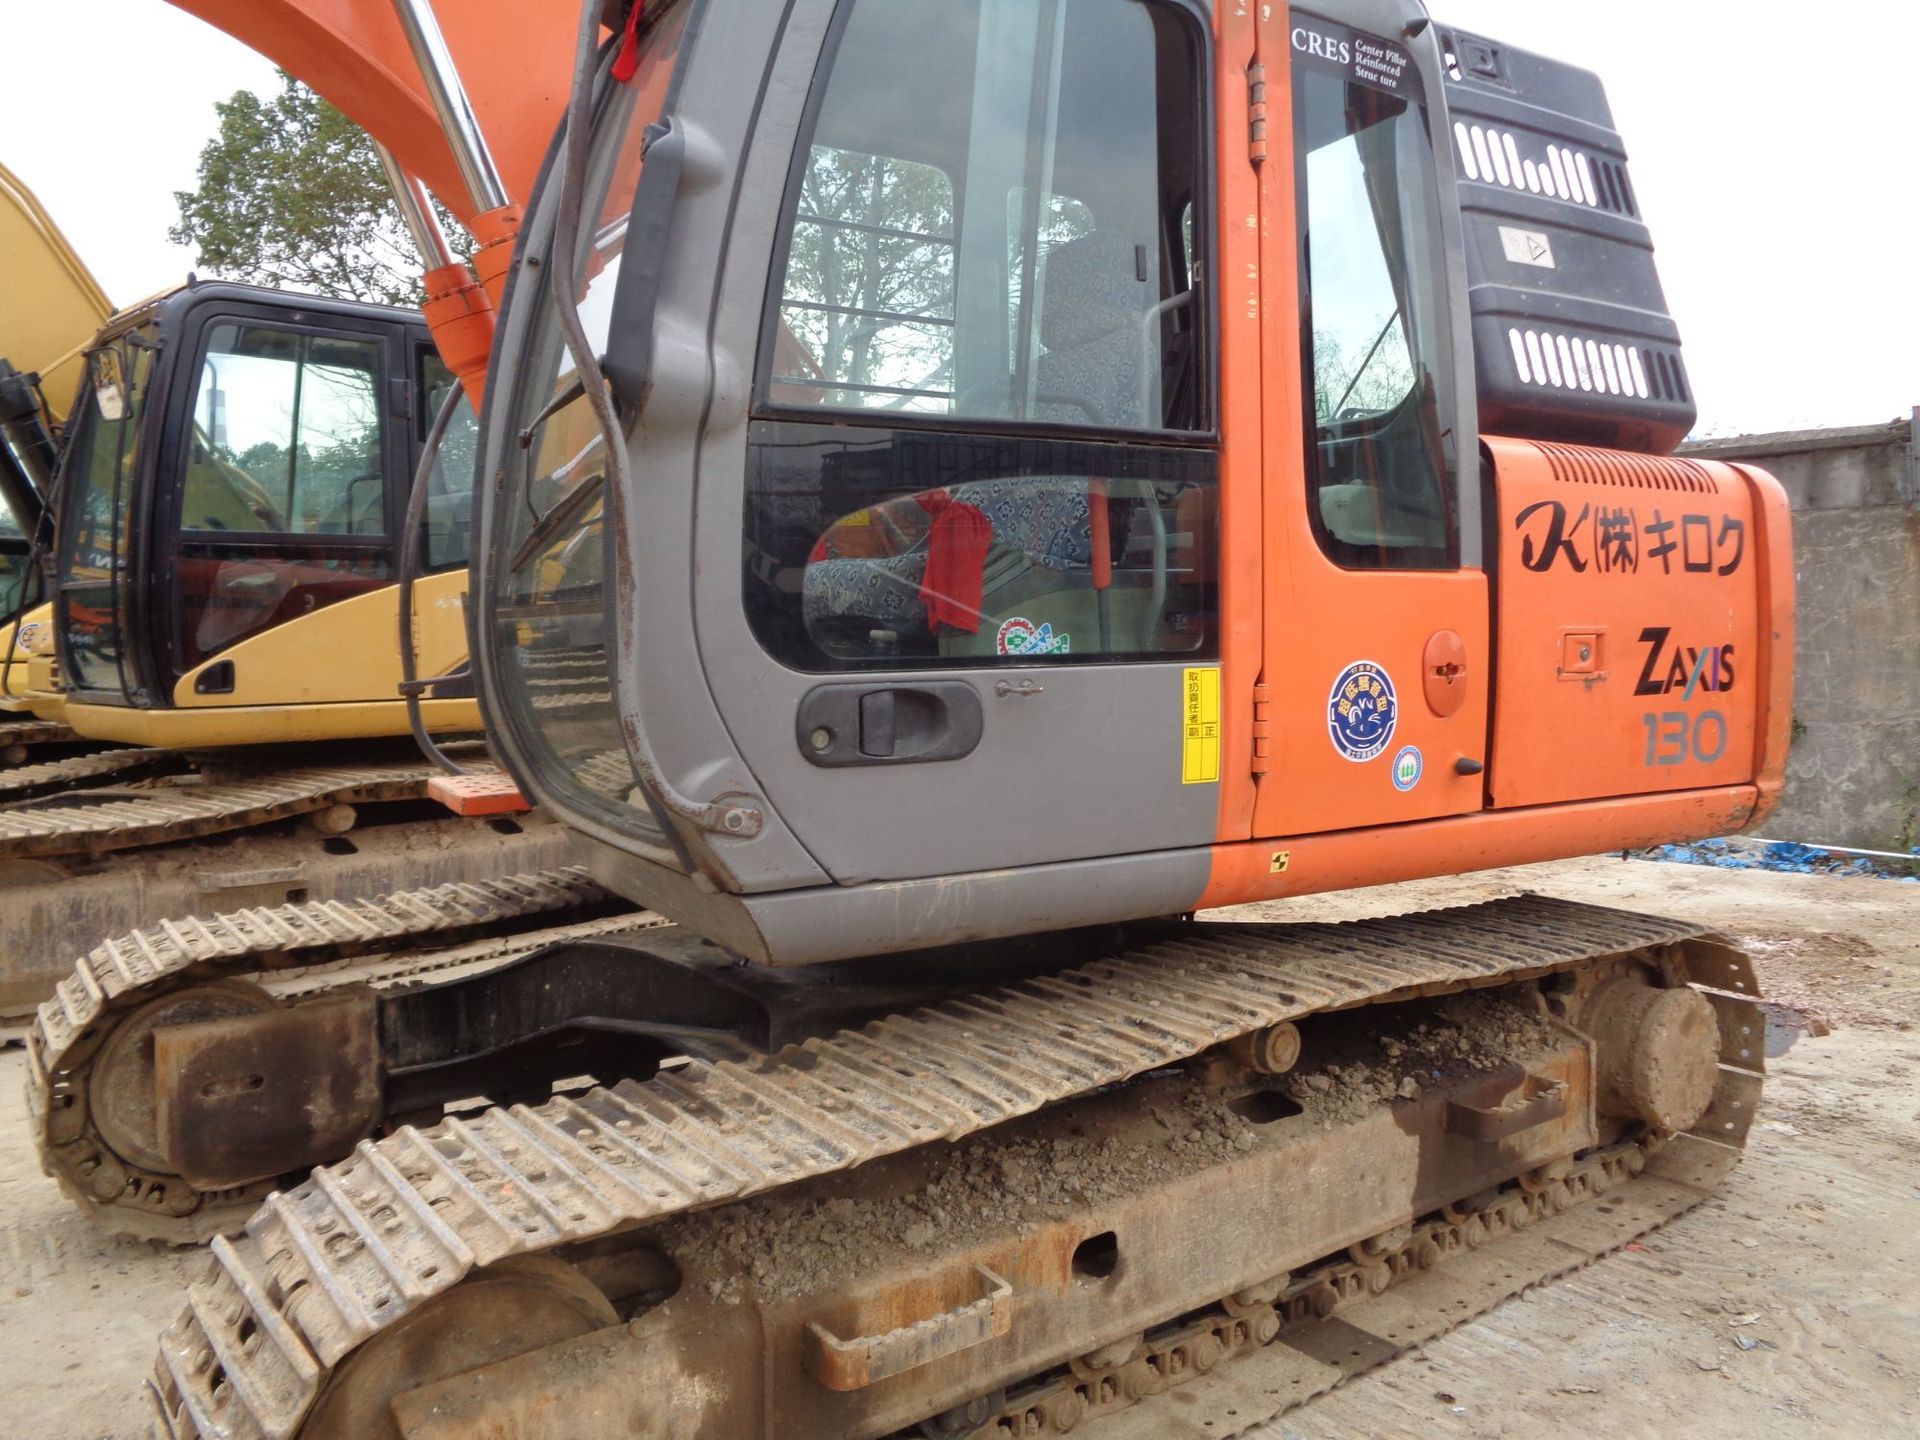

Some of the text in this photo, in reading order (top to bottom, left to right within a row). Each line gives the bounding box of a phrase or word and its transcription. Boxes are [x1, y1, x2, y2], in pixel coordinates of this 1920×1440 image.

[1291, 28, 1350, 64] CRES
[1355, 39, 1407, 67] Center Pillar
[1355, 52, 1401, 77] Reinforced
[1633, 626, 1735, 702] ZAXIS
[1204, 726, 1216, 737] 正
[1643, 709, 1728, 767] 130
